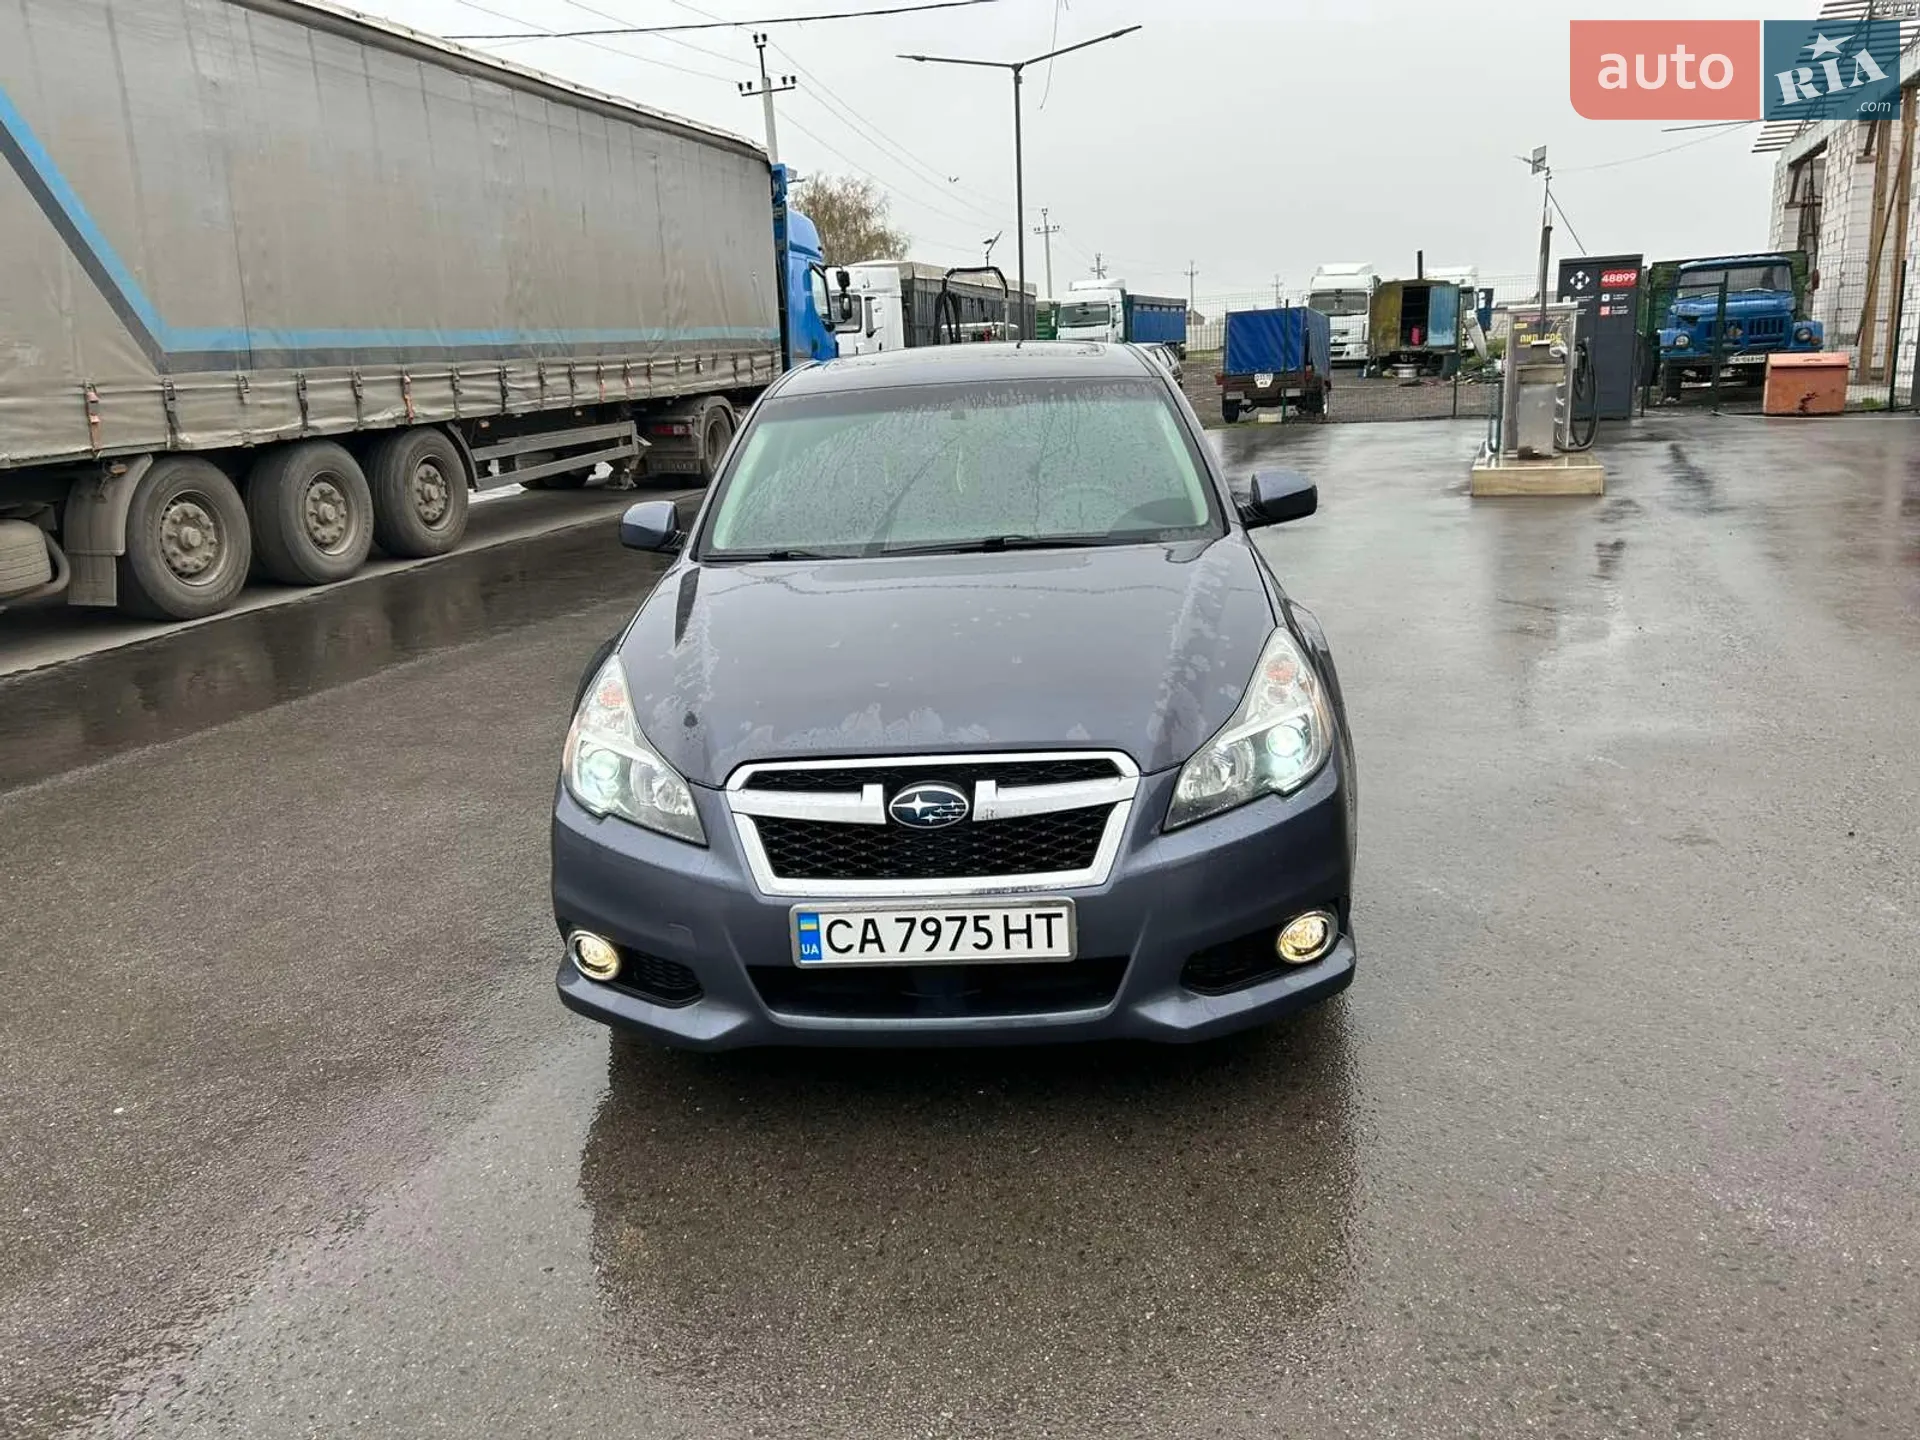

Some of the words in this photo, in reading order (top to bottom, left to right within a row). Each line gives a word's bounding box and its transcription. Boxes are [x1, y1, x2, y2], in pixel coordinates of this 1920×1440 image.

[1601, 273, 1637, 283] 48899
[825, 917, 886, 954] CA
[894, 914, 993, 953] 7975
[1003, 912, 1063, 950] HT
[801, 943, 819, 956] UA
